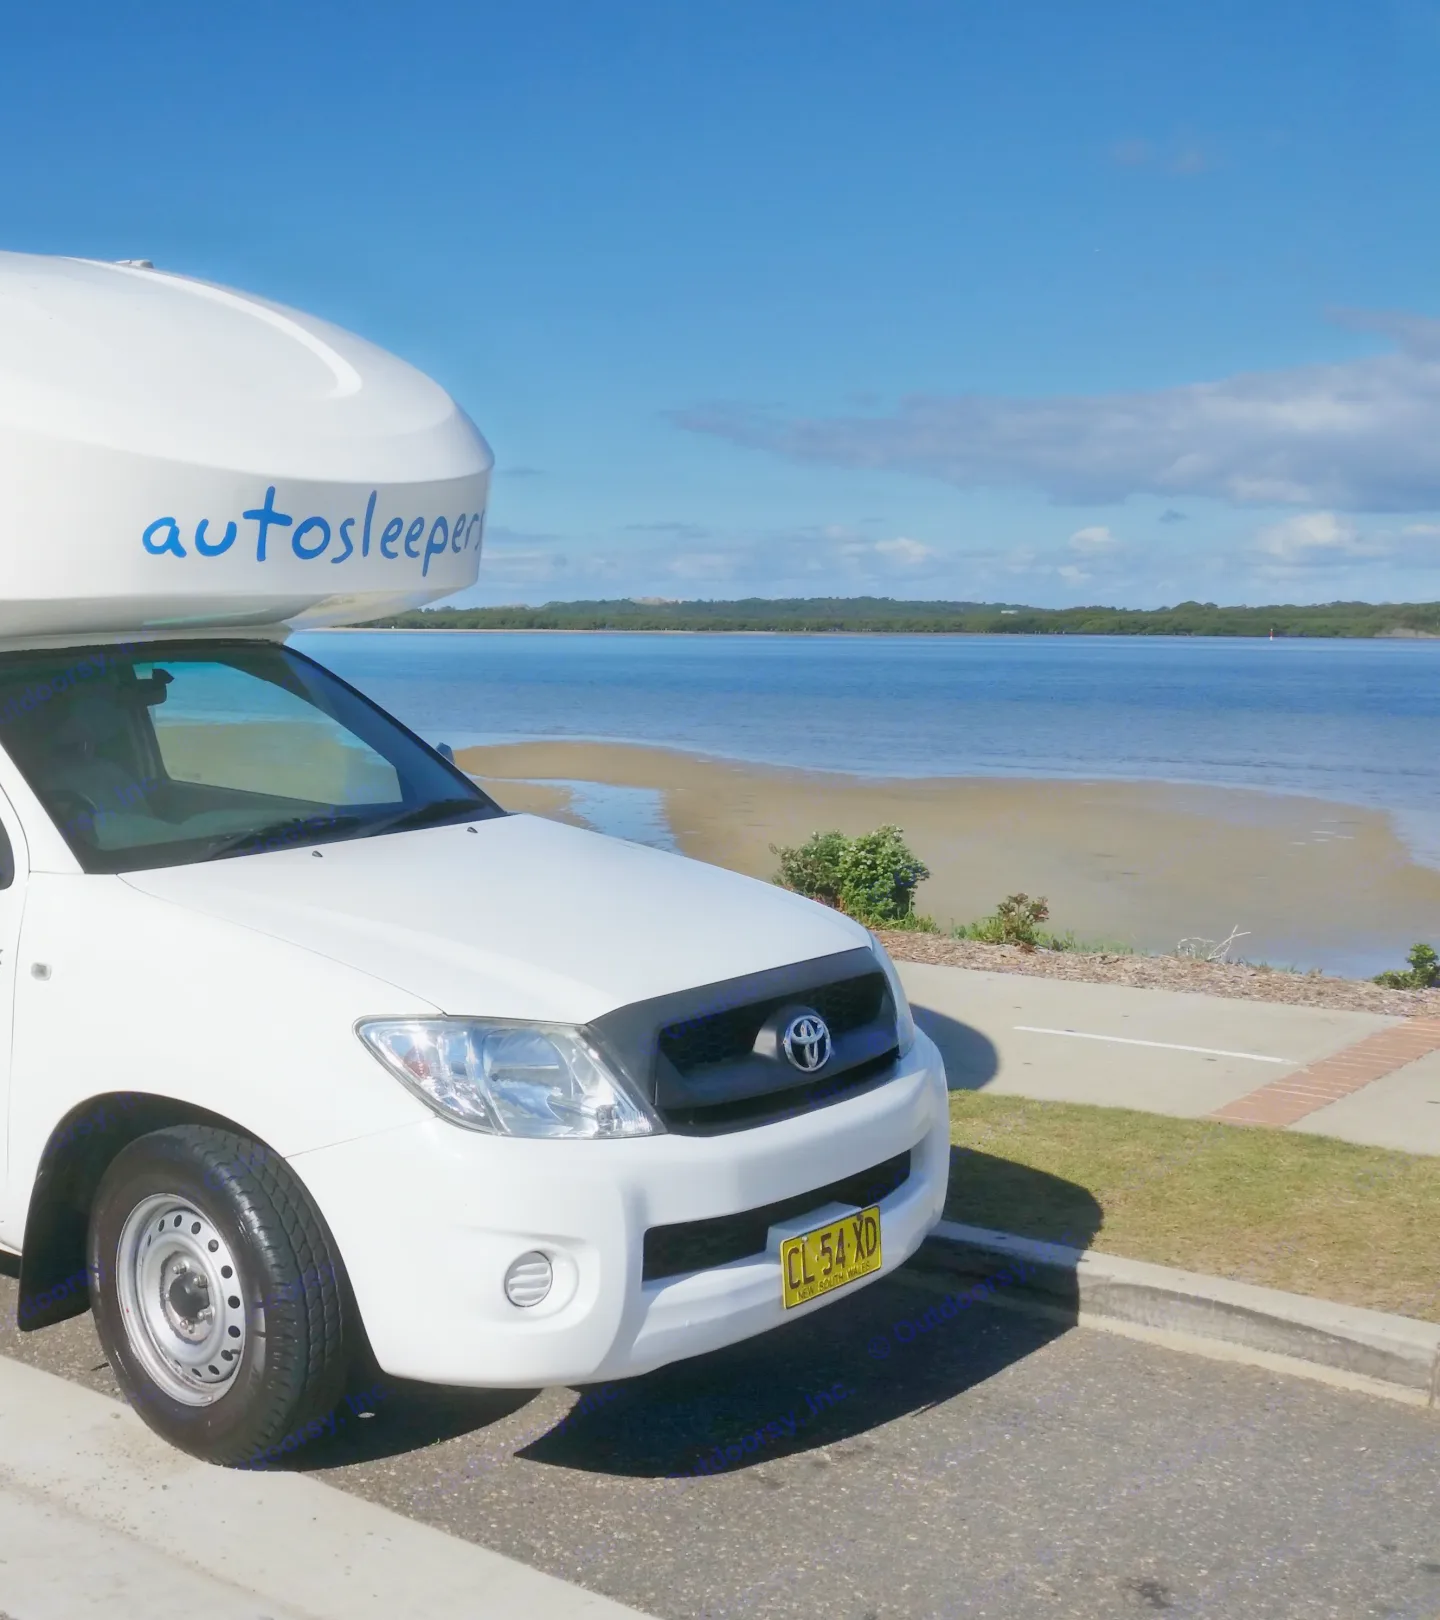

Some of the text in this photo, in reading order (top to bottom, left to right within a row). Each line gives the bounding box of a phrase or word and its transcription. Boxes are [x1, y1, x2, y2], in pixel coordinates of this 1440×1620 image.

[142, 486, 485, 577] autosleepers
[787, 1216, 878, 1290] CL 54 XD
[797, 1262, 870, 1301] NEW SOUTH WALES
